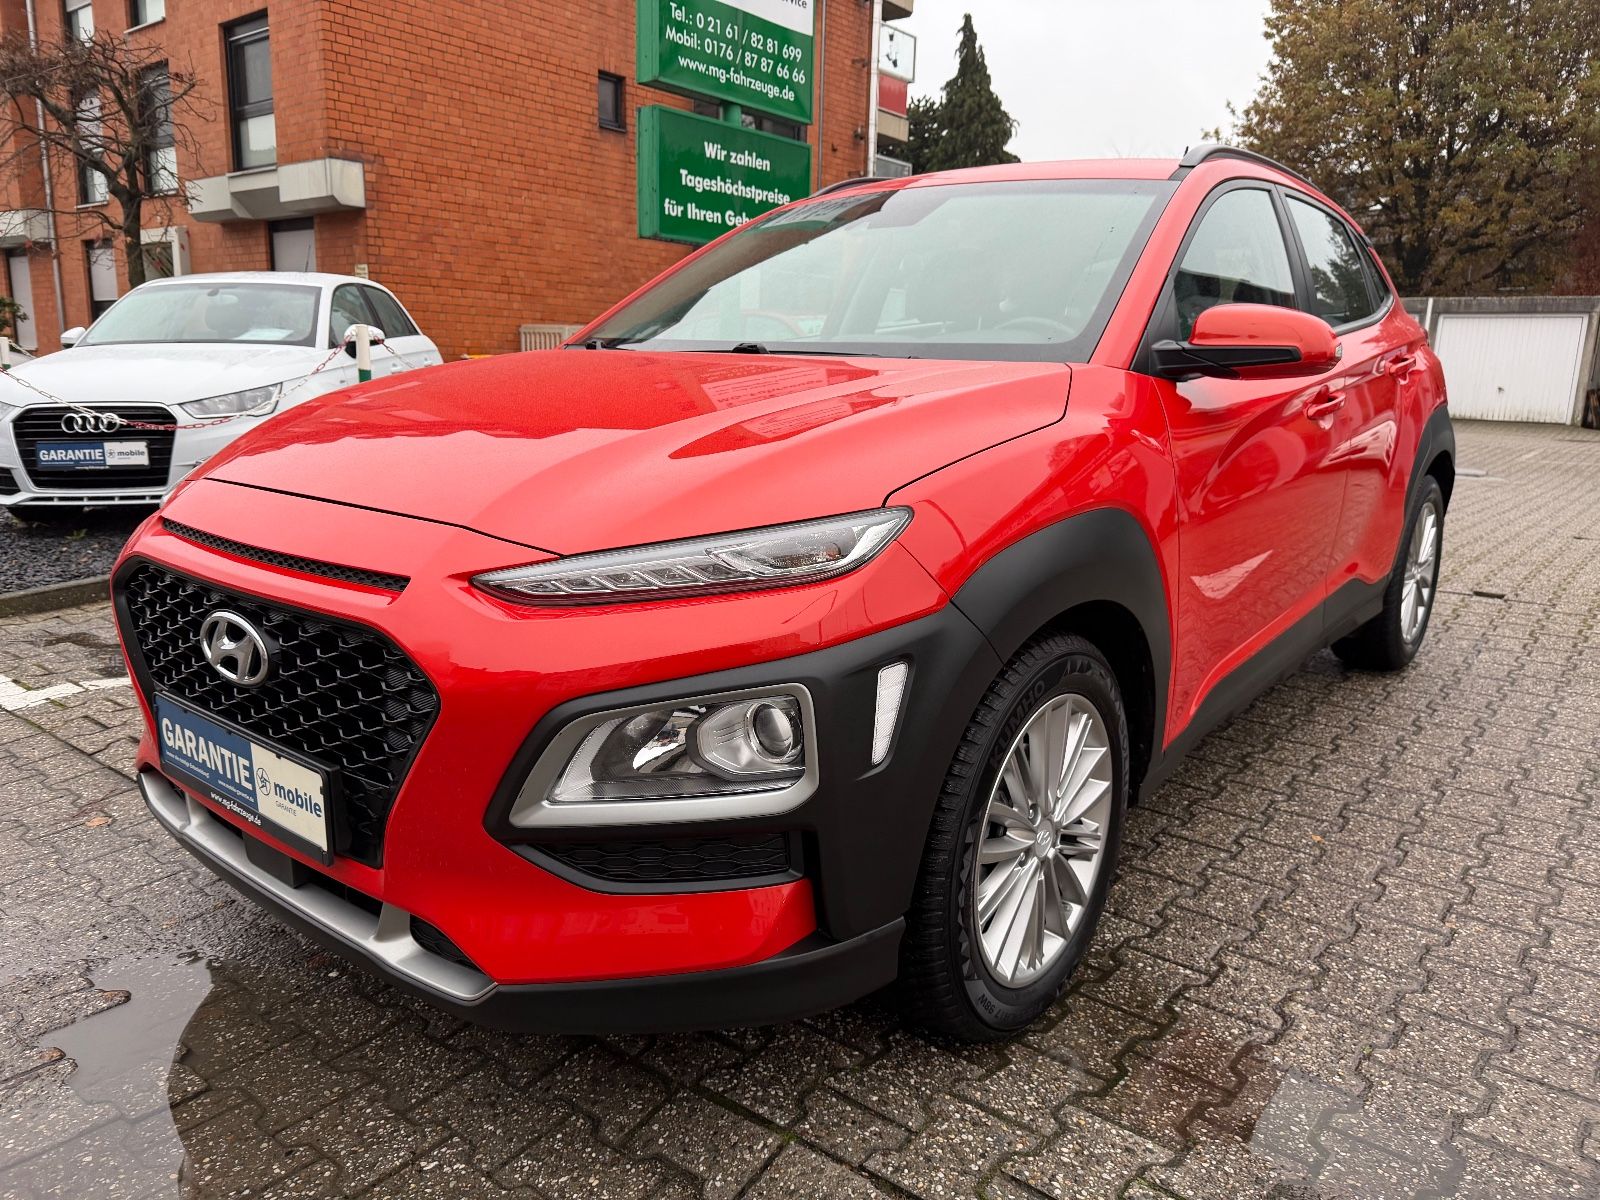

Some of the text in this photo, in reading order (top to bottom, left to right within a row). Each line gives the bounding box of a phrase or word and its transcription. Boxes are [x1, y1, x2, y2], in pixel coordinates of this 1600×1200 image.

[669, 2, 802, 63] Tel.: 0 21 61 / 82 81 699
[665, 24, 806, 84] Mobil: 0176 / 87 87 66 66
[678, 55, 795, 101] www.mg-fahrzeuge.de
[704, 141, 771, 171] Wir zahlen
[679, 168, 791, 205] Tageshöchstpreise
[664, 198, 753, 226] für Ihren Geb
[39, 449, 145, 461] GARANTIE mobile
[161, 717, 254, 790] GARANTIE
[274, 781, 322, 818] mobile
